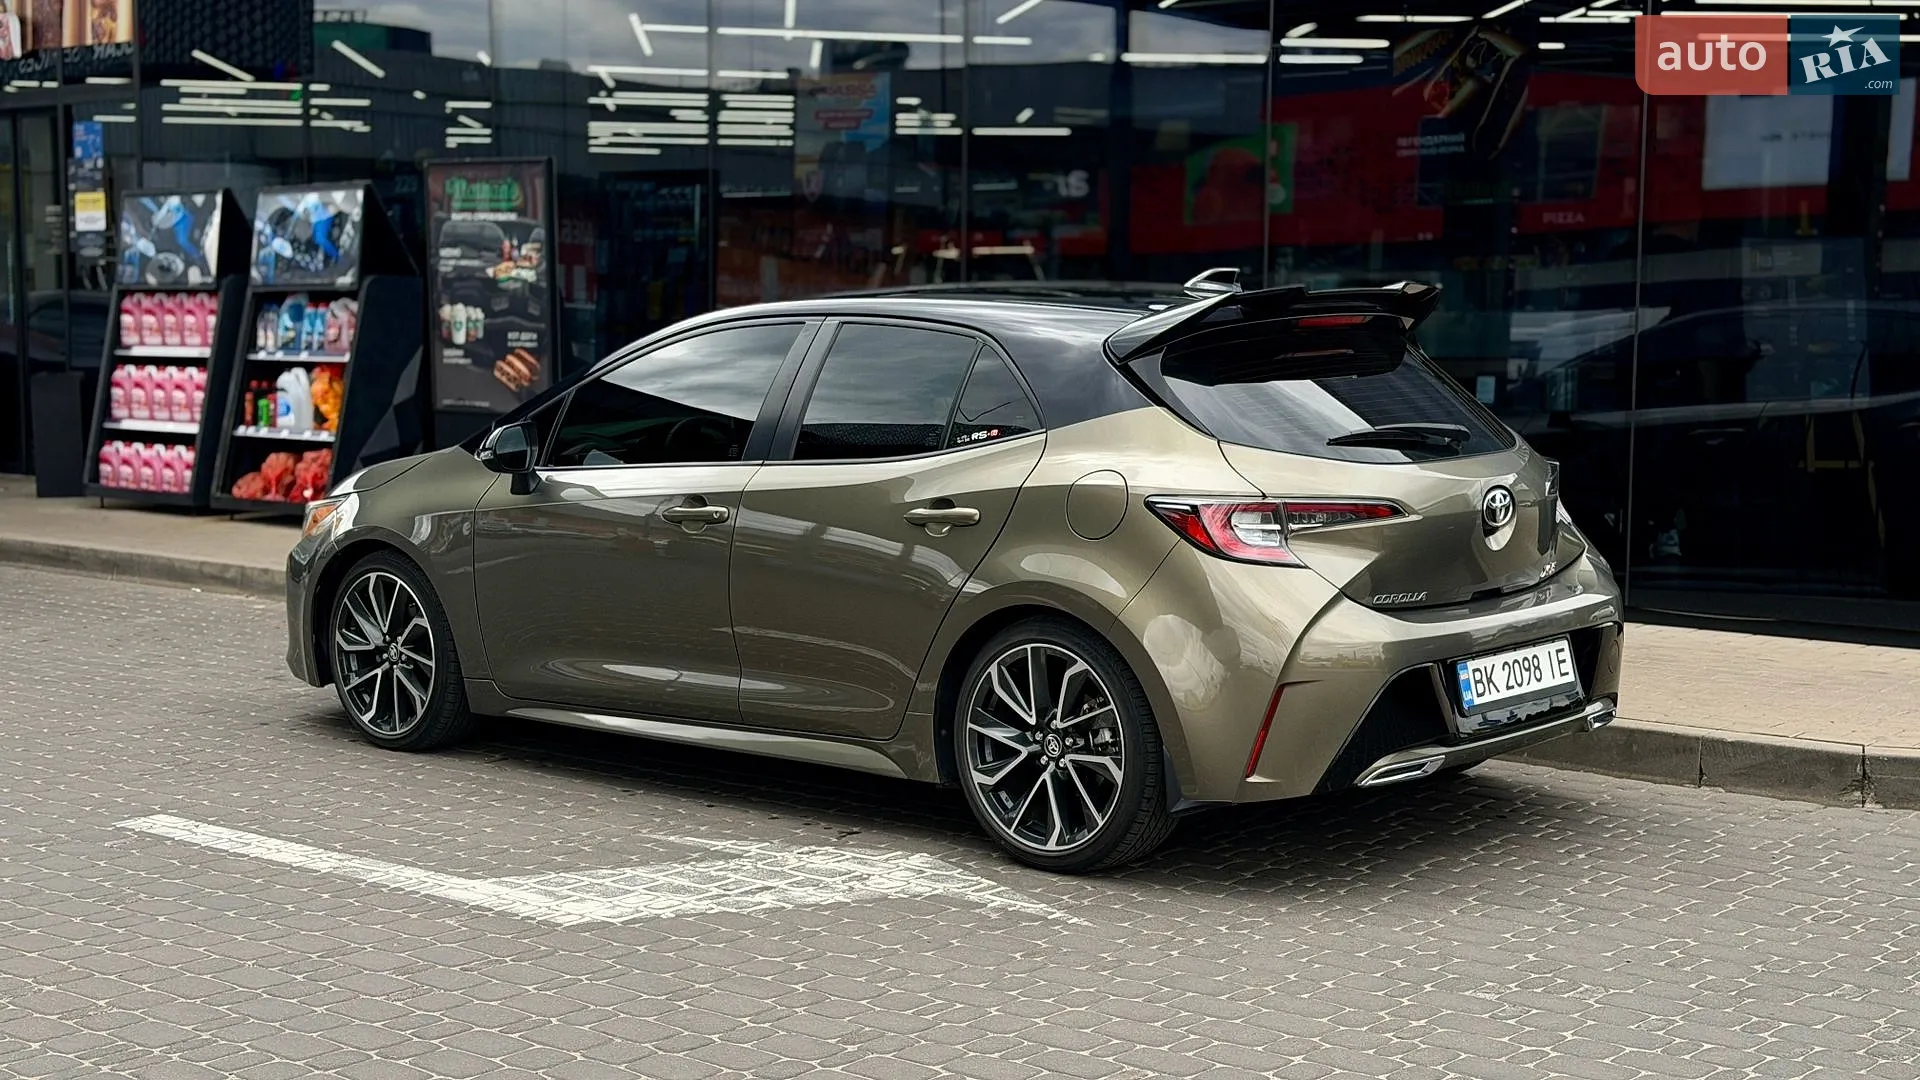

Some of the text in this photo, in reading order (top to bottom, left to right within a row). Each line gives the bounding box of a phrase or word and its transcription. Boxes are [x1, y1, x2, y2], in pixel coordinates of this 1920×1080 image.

[1542, 211, 1585, 225] PIZZA
[1373, 592, 1428, 605] COROLLA
[1472, 647, 1569, 698] BK 2098 IE
